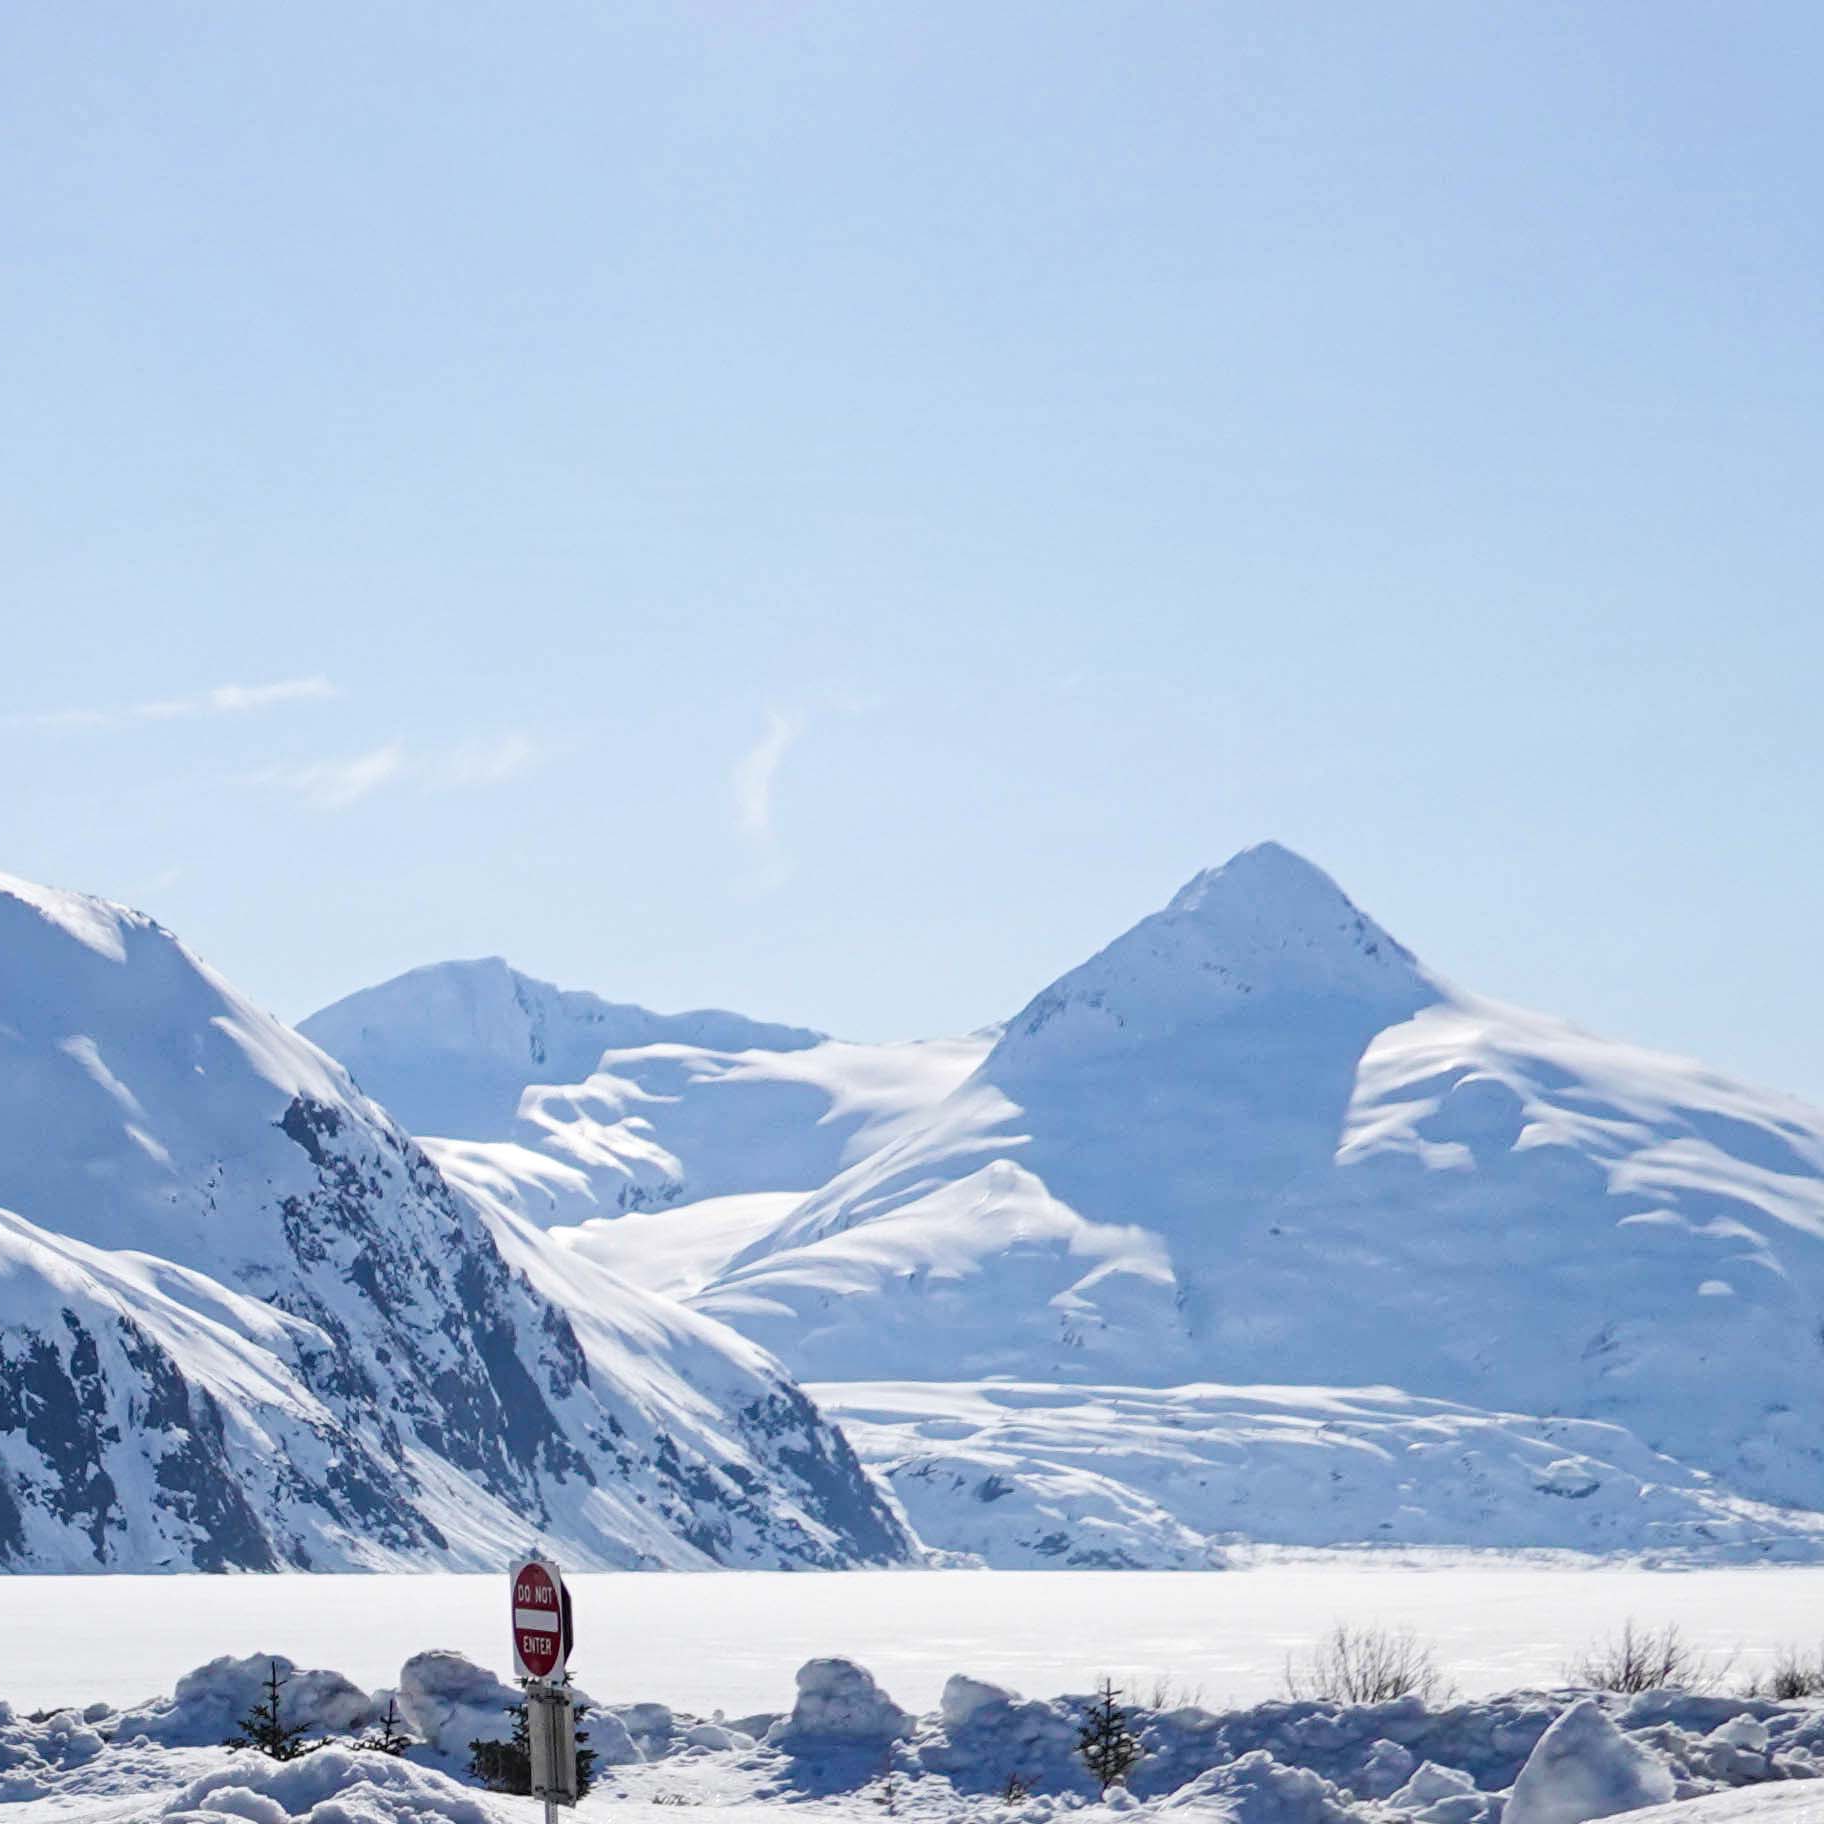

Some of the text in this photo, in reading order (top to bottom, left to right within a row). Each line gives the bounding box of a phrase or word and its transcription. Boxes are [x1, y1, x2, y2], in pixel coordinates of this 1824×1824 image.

[518, 1584, 553, 1604] DO NOT
[523, 1636, 552, 1656] ENTER
